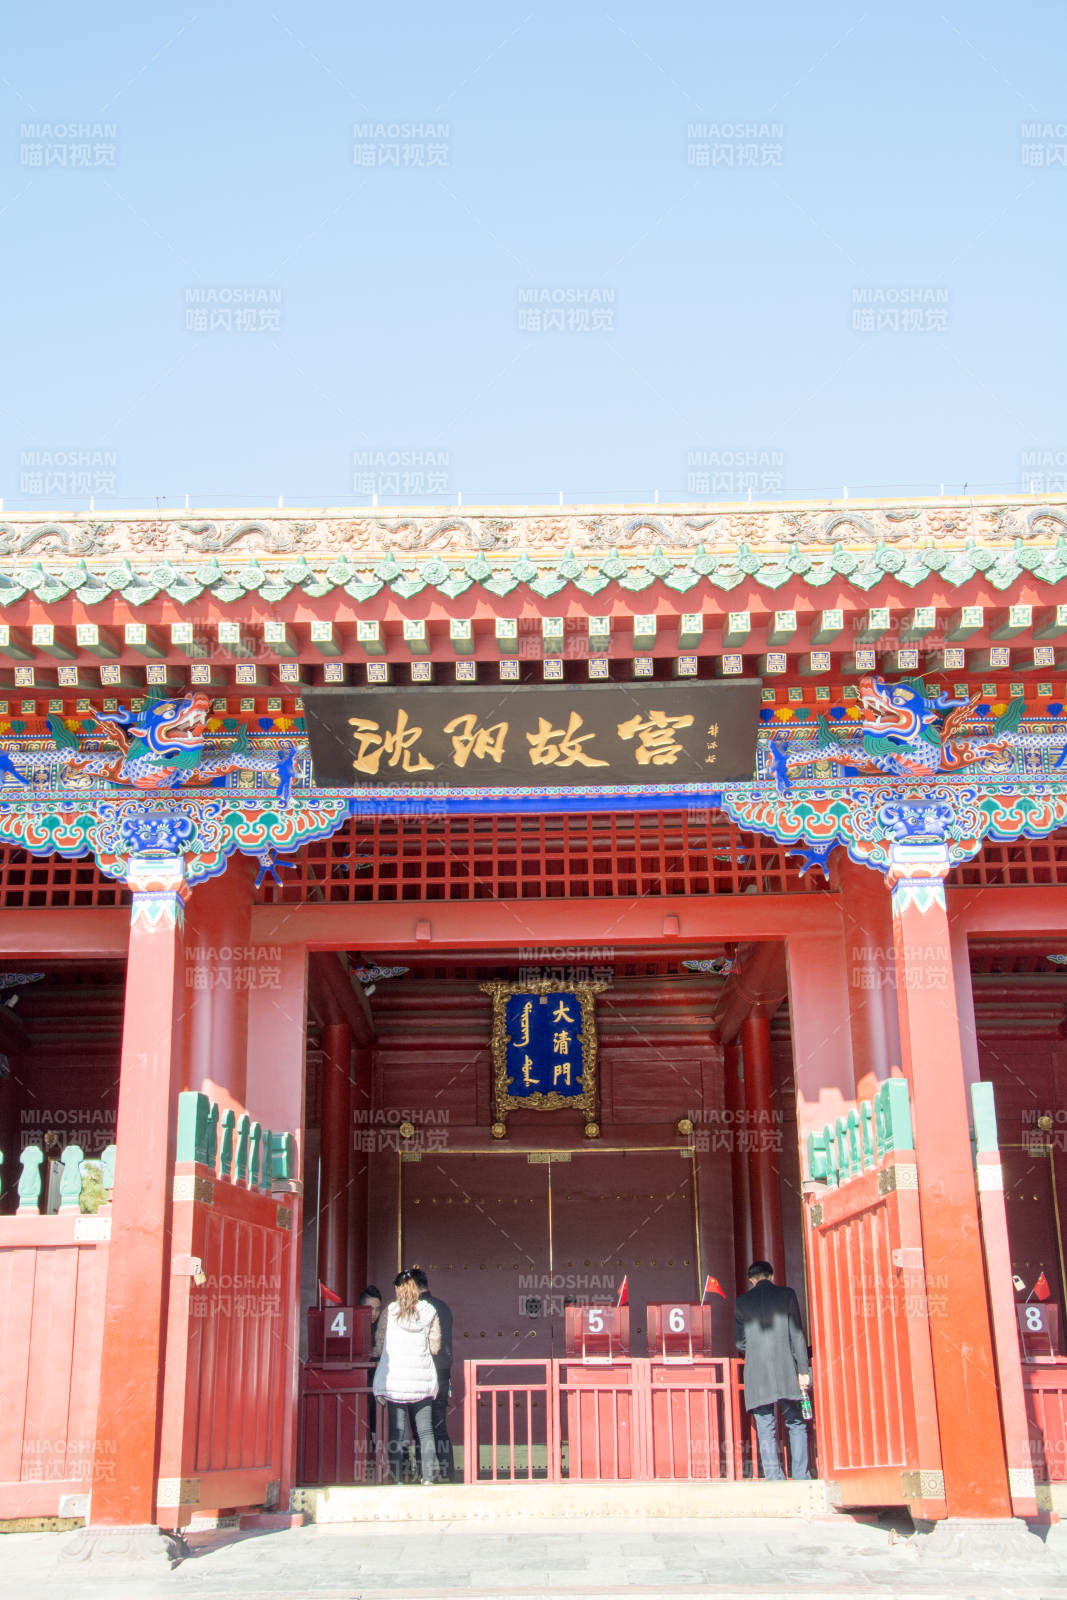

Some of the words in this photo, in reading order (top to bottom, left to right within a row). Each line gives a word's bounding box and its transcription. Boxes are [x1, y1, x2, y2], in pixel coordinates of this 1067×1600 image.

[330, 1311, 347, 1337] 4
[588, 1309, 604, 1333] 5
[668, 1308, 685, 1333] 6
[1025, 1306, 1043, 1331] 8
